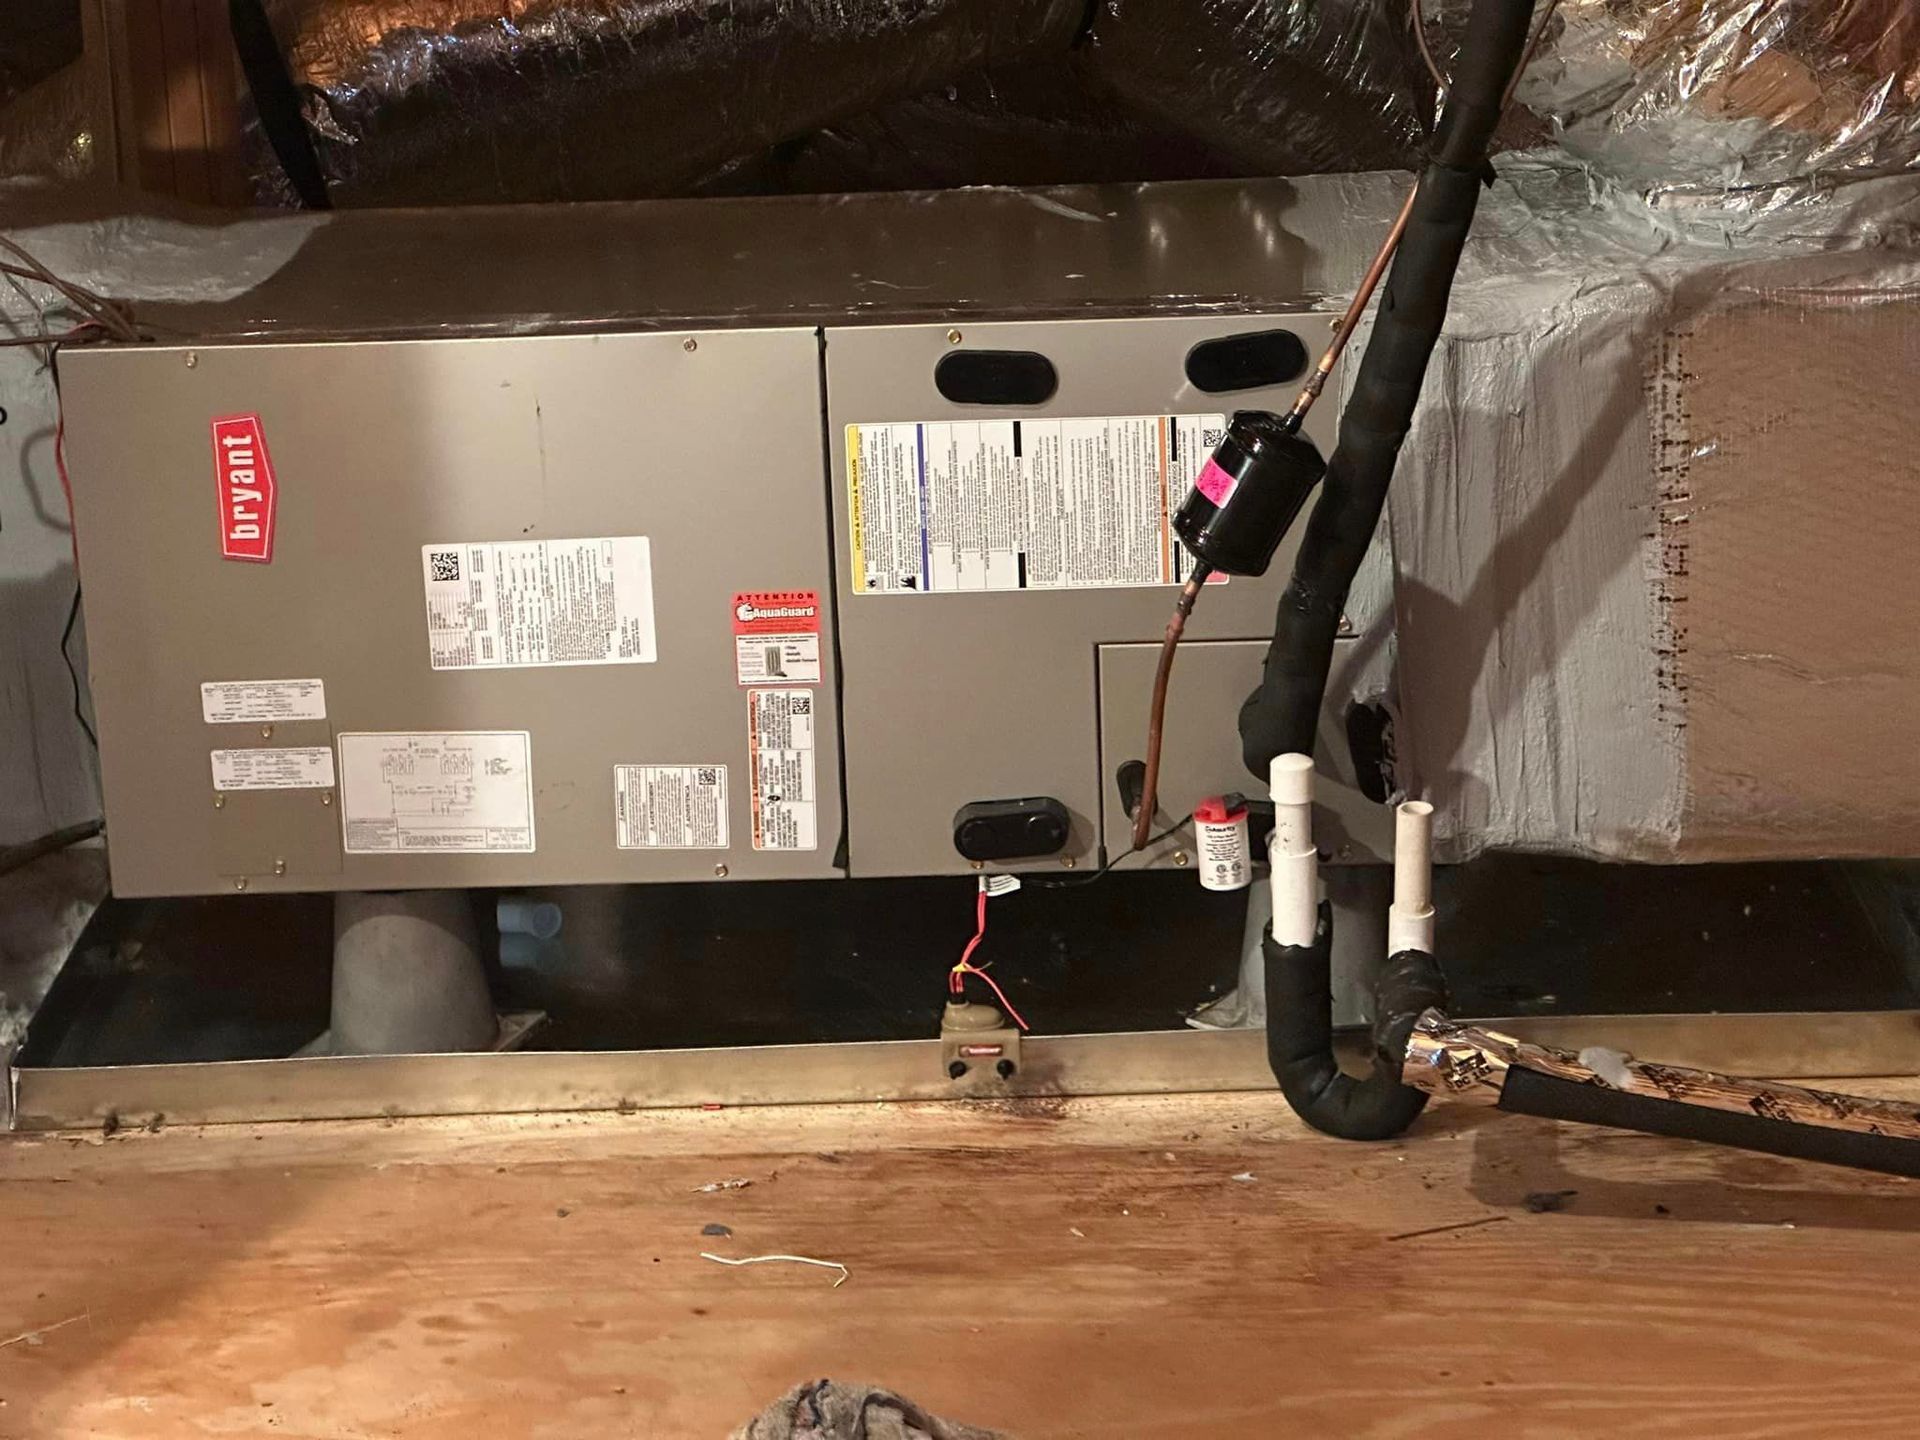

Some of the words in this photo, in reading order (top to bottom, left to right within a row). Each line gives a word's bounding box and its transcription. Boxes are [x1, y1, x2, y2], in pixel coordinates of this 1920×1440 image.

[222, 435, 263, 540] bryant
[737, 593, 814, 601] ATTENTION
[753, 606, 814, 619] AquaGuard
